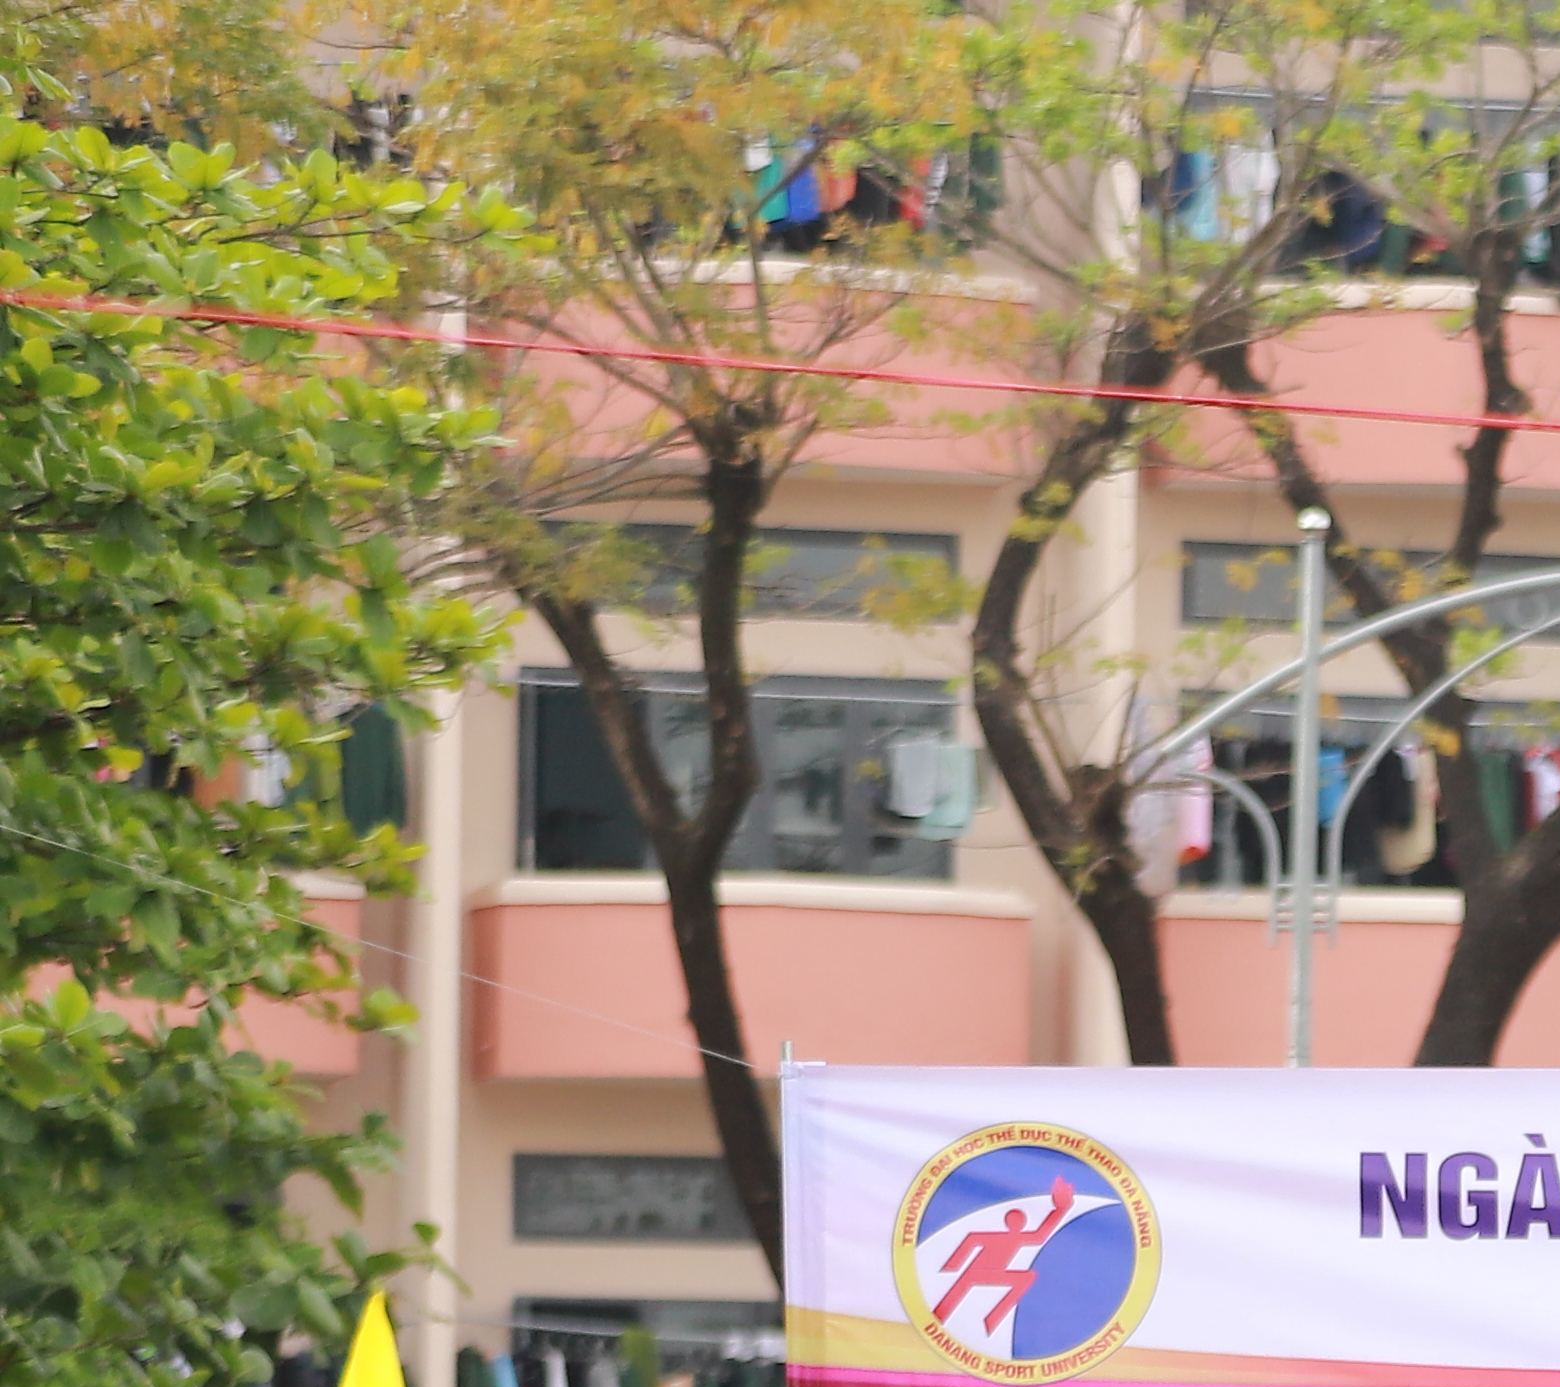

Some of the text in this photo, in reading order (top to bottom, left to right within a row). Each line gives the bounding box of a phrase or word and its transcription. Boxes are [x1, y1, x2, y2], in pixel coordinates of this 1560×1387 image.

[902, 1177, 932, 1247] TRƯỜNG
[954, 1137, 985, 1160] HỌC
[1019, 1128, 1052, 1143] DỤC
[1087, 1148, 1122, 1178] THAO
[923, 1320, 1127, 1380] DANANG SPORT UNIVERSITY
